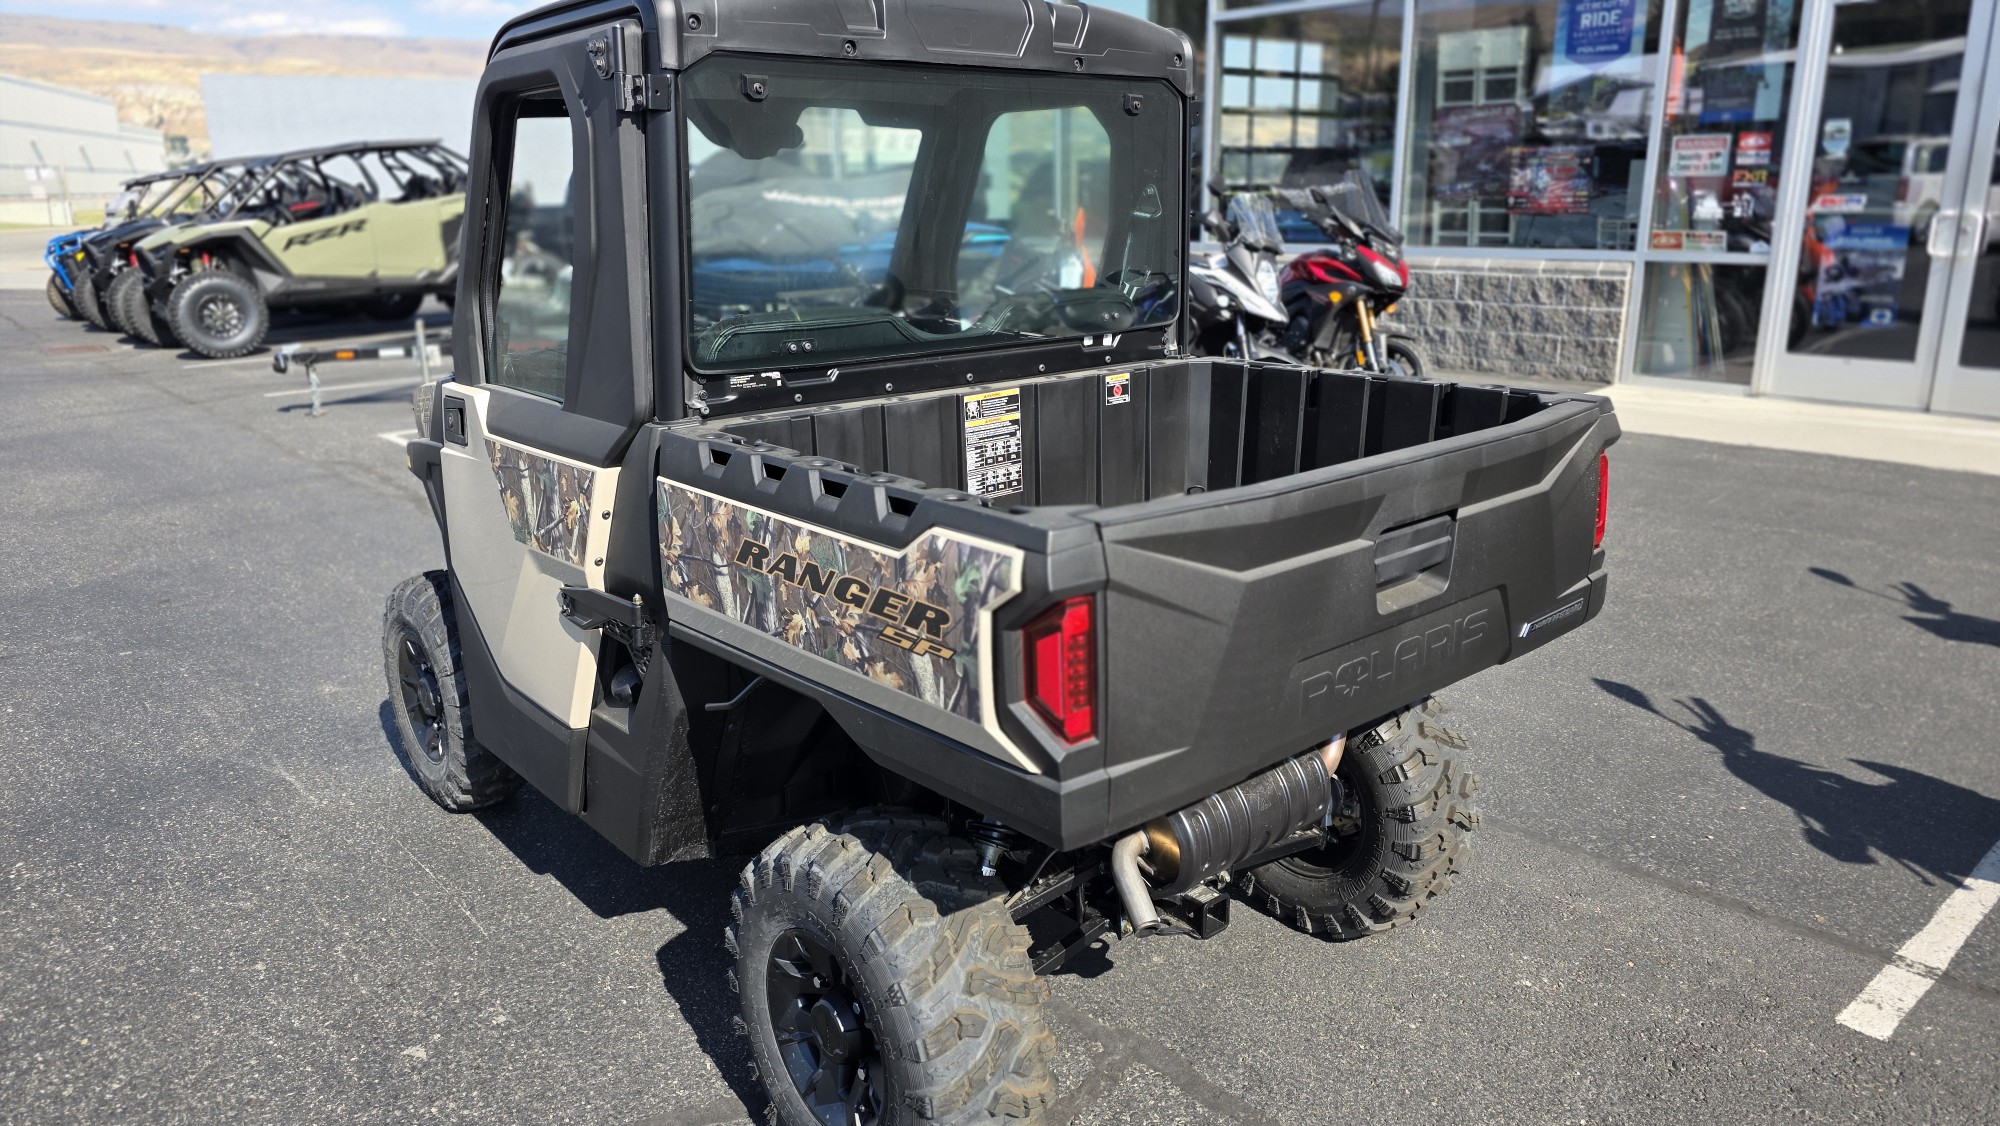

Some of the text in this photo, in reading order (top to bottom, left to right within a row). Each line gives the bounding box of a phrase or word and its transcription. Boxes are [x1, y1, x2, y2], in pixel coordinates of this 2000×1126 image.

[1579, 9, 1622, 30] RIDE
[1576, 44, 1619, 54] POLARIS
[282, 218, 367, 253] RZR
[733, 538, 952, 641] RANGER
[877, 624, 956, 660] SP
[1301, 608, 1488, 698] POLARIS
